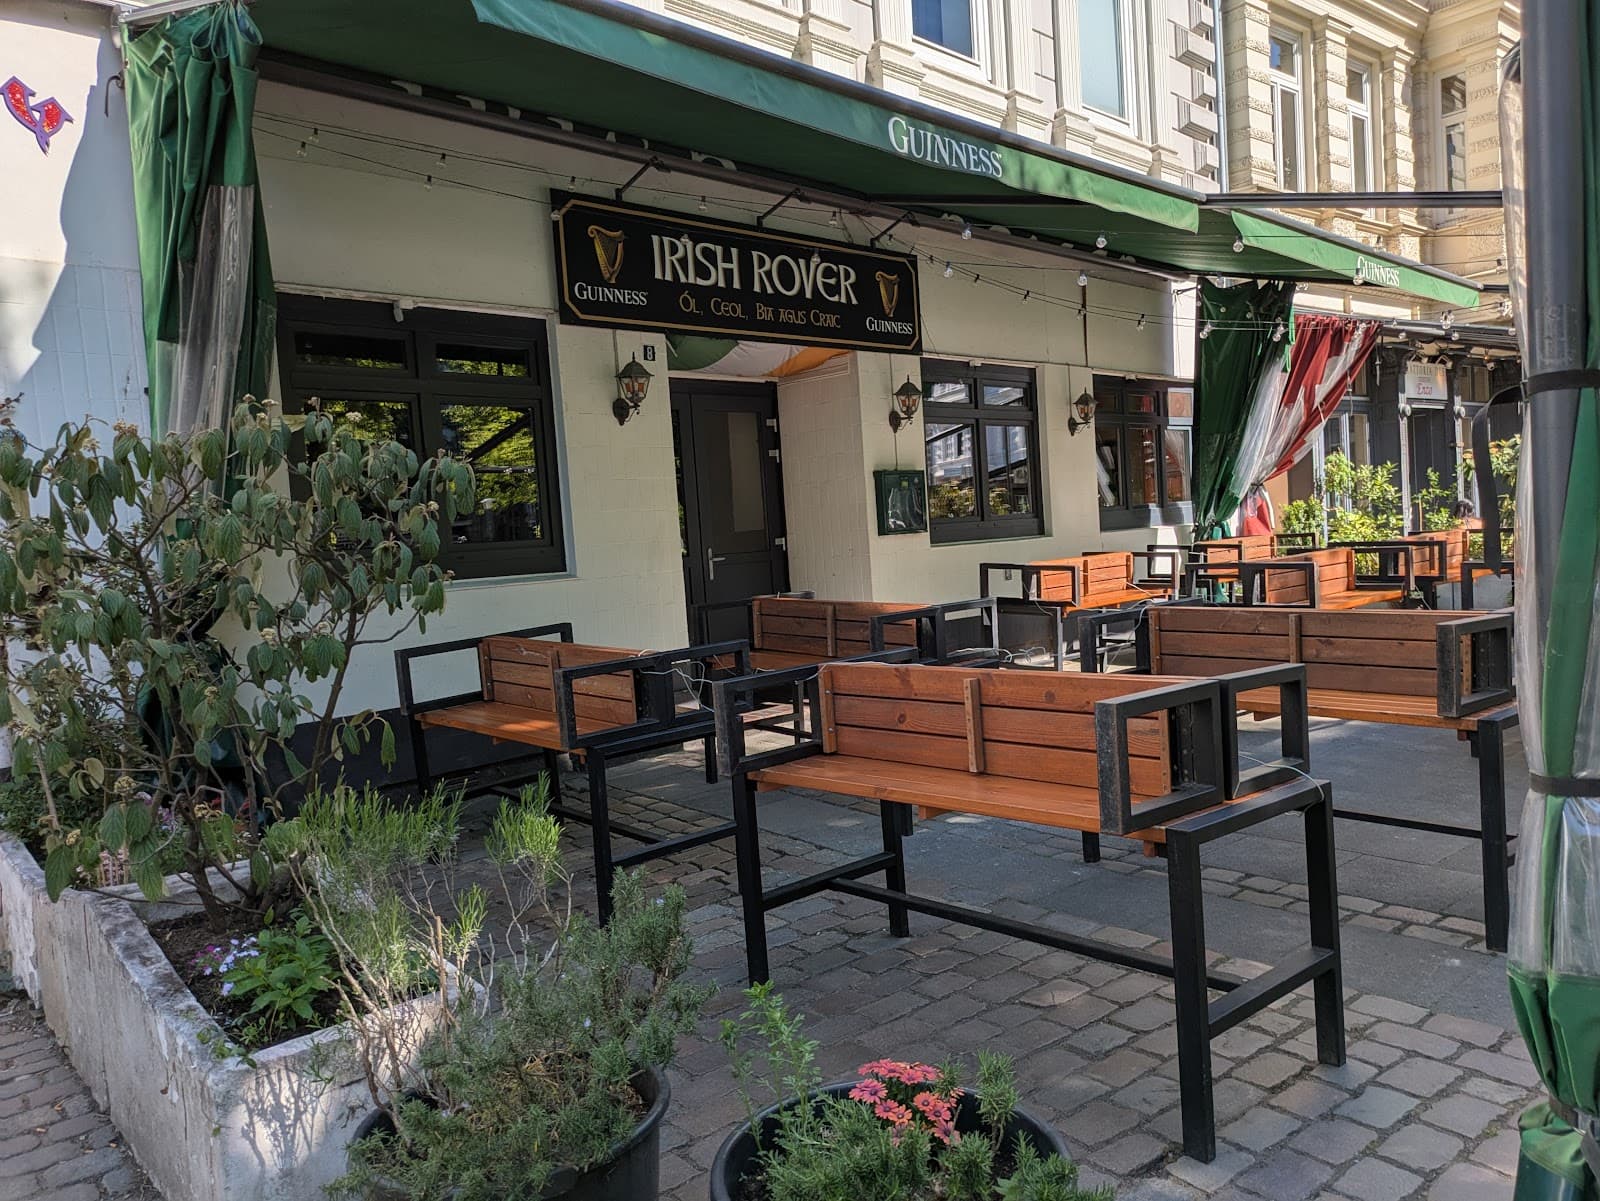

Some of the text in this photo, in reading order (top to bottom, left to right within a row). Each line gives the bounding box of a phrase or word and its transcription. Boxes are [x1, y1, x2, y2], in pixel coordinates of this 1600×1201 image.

[888, 116, 1002, 178] GUINNESS
[651, 234, 859, 304] IRISH ROVER
[1357, 255, 1400, 287] GUINNESS
[574, 281, 648, 306] GUINNESS
[866, 316, 913, 335] GUINNESS
[646, 346, 653, 360] 8
